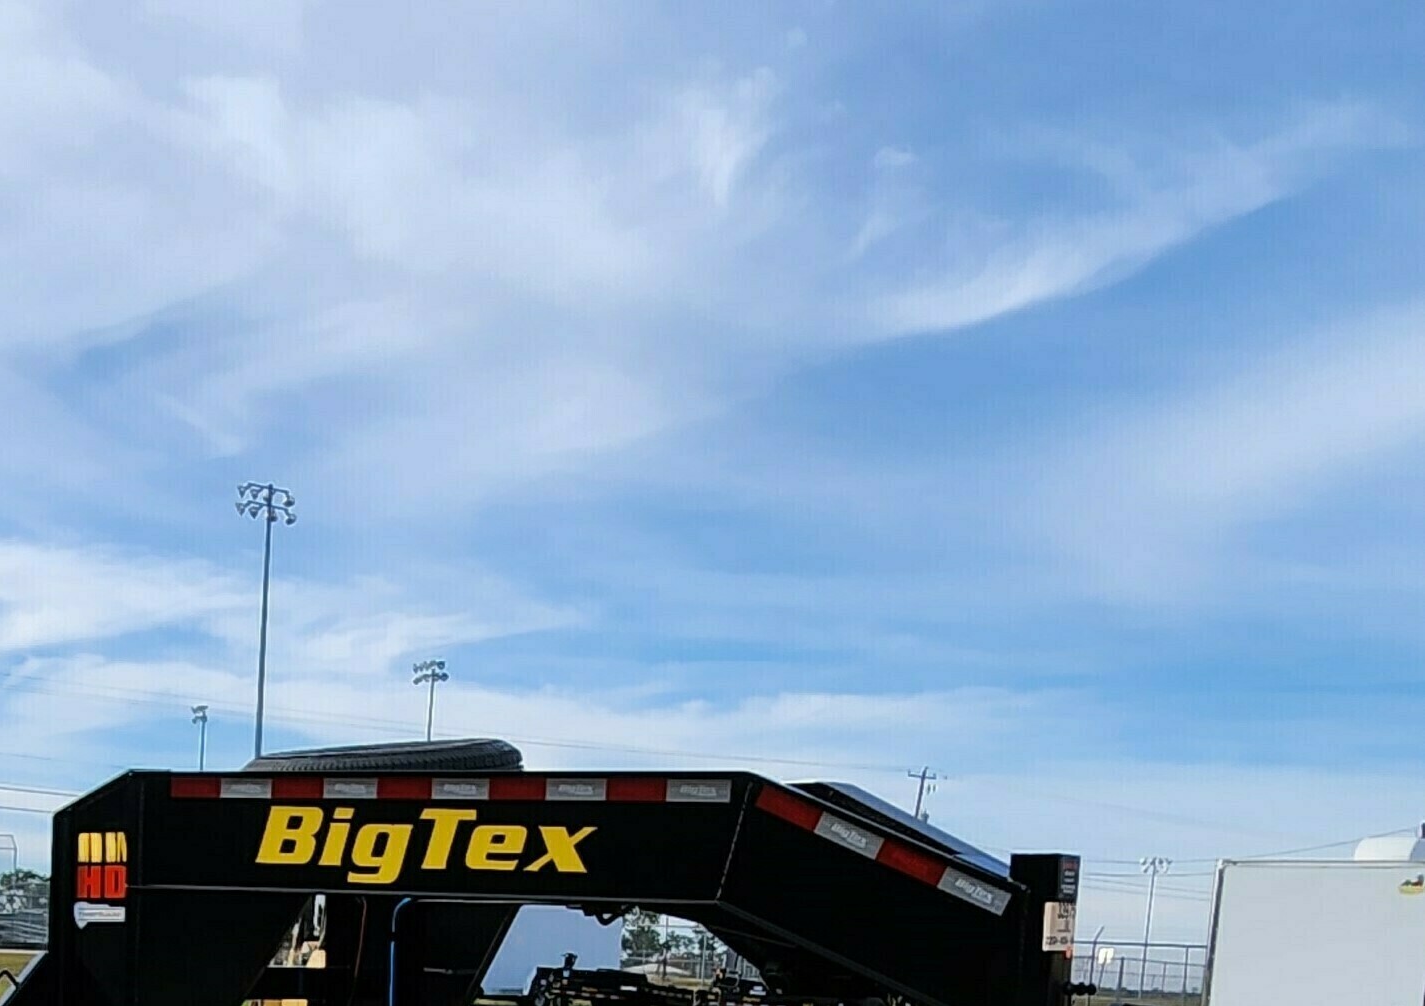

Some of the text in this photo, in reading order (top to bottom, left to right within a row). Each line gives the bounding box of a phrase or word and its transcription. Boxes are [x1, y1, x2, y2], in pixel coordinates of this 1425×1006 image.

[255, 806, 598, 884] BigTex
[831, 823, 868, 847] BigTex
[77, 865, 126, 898] HD
[955, 878, 994, 904] BigTex
